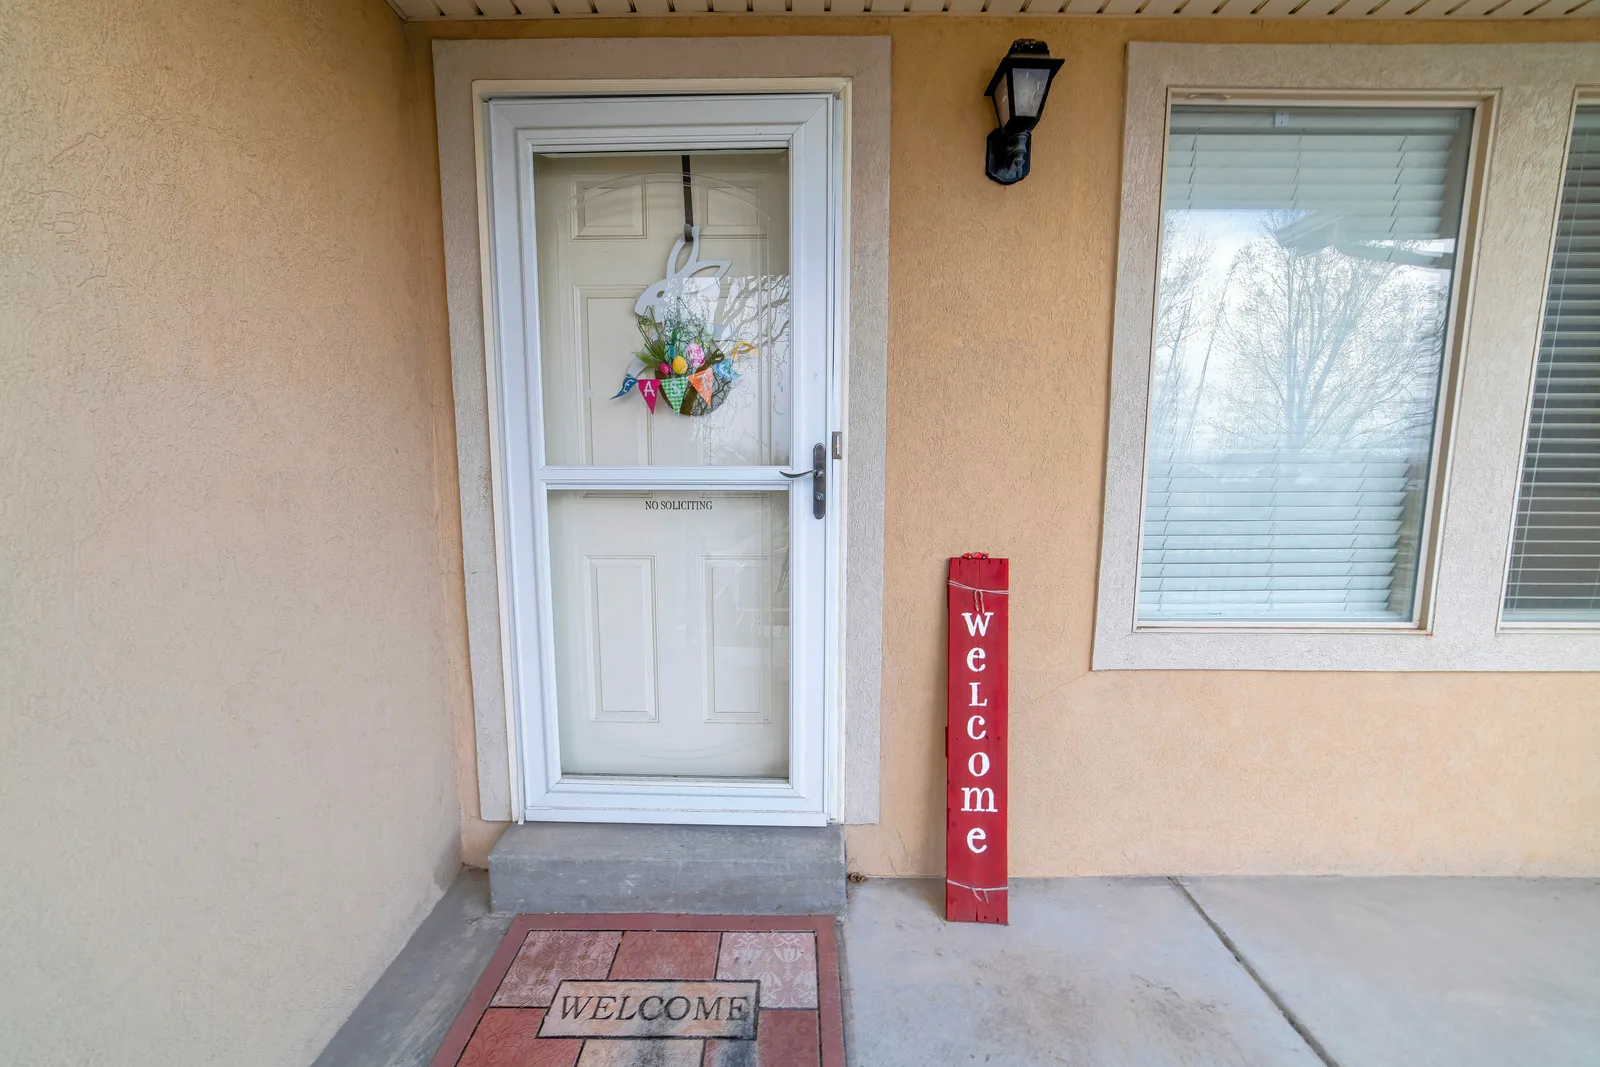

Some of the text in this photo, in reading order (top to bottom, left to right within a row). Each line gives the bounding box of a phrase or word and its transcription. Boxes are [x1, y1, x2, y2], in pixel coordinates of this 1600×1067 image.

[645, 500, 713, 510] NO SOLICITING
[561, 995, 749, 1021] WELCOME
